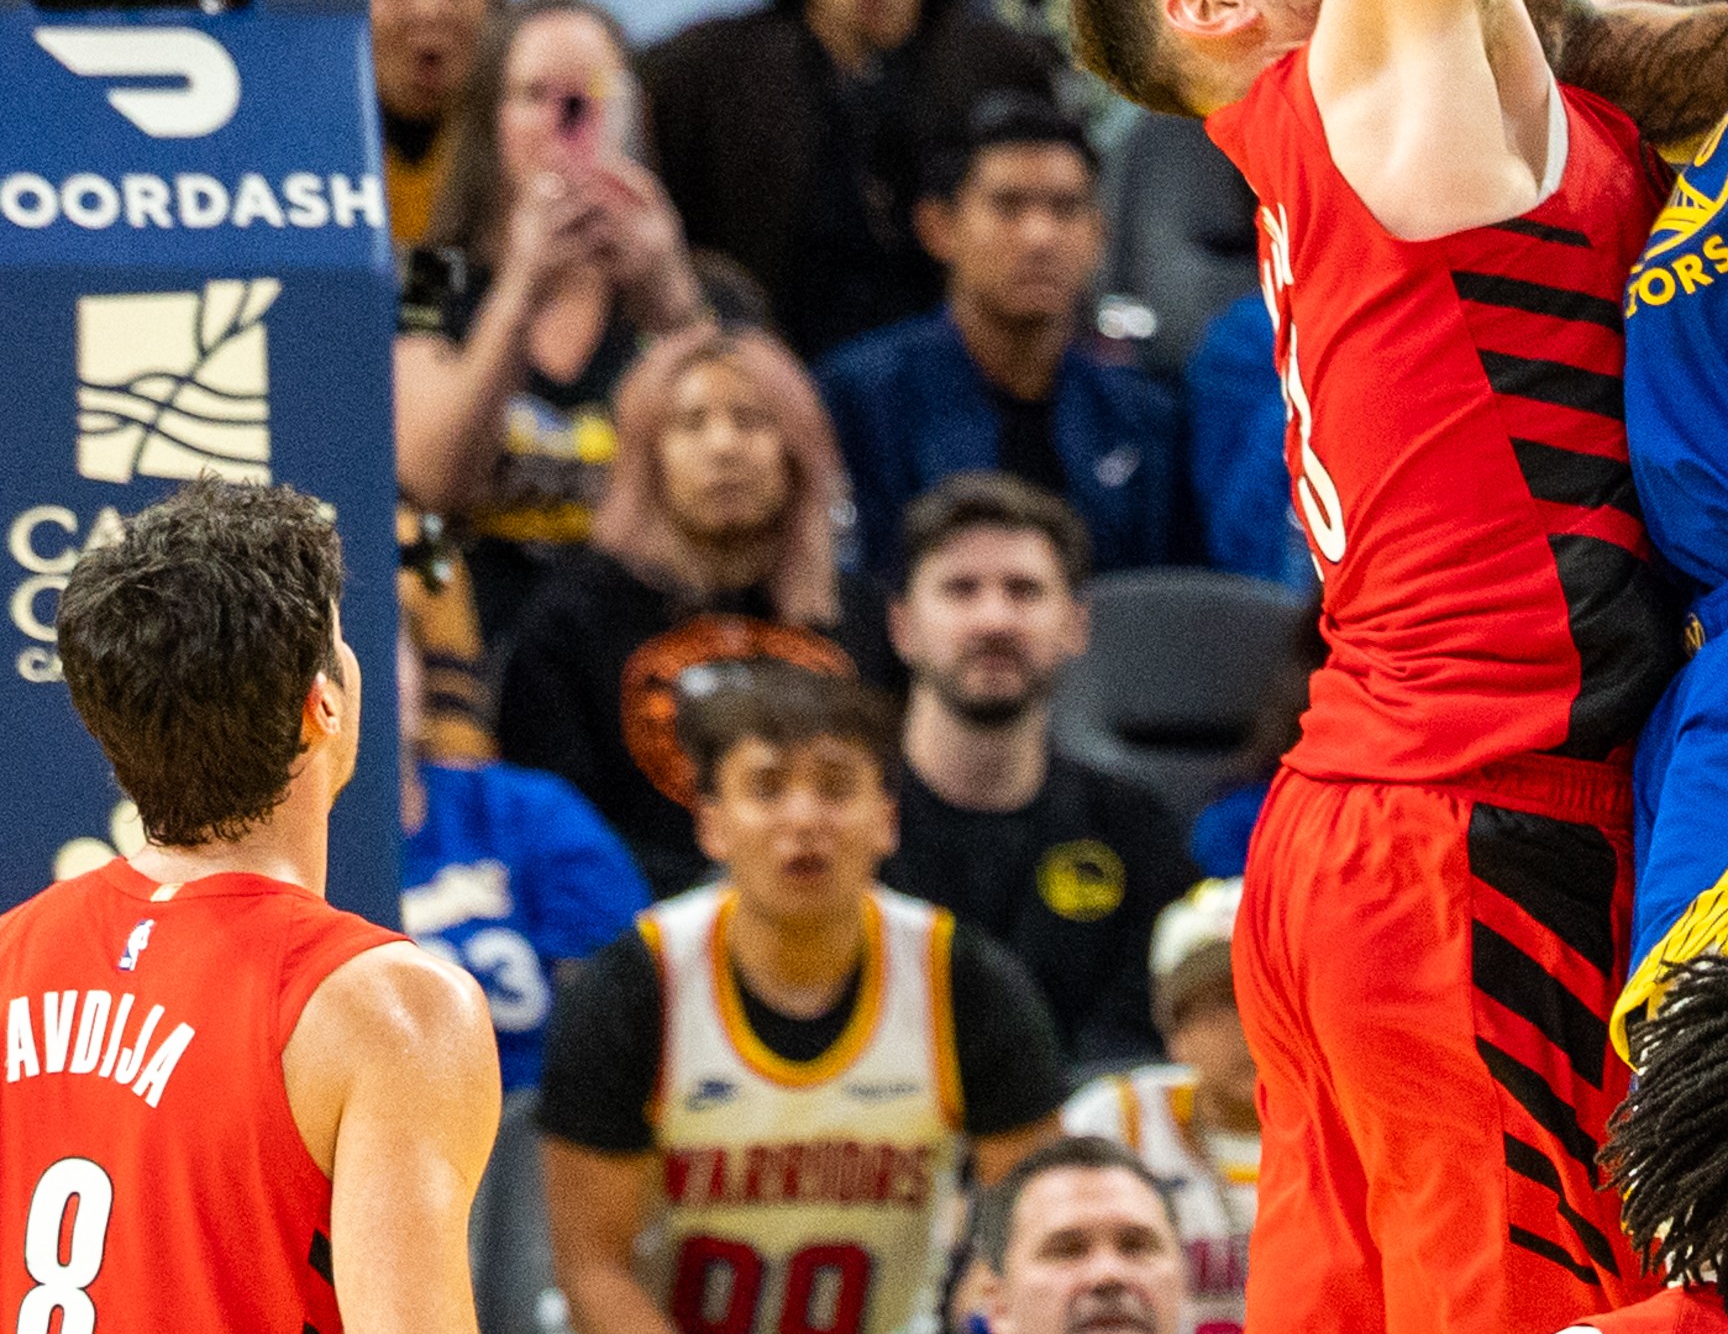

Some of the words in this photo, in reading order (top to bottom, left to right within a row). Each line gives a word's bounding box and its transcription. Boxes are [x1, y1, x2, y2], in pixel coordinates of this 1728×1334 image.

[1, 171, 387, 230] OORDASH
[417, 928, 555, 1031] 3
[6, 989, 196, 1110] AVDIJA
